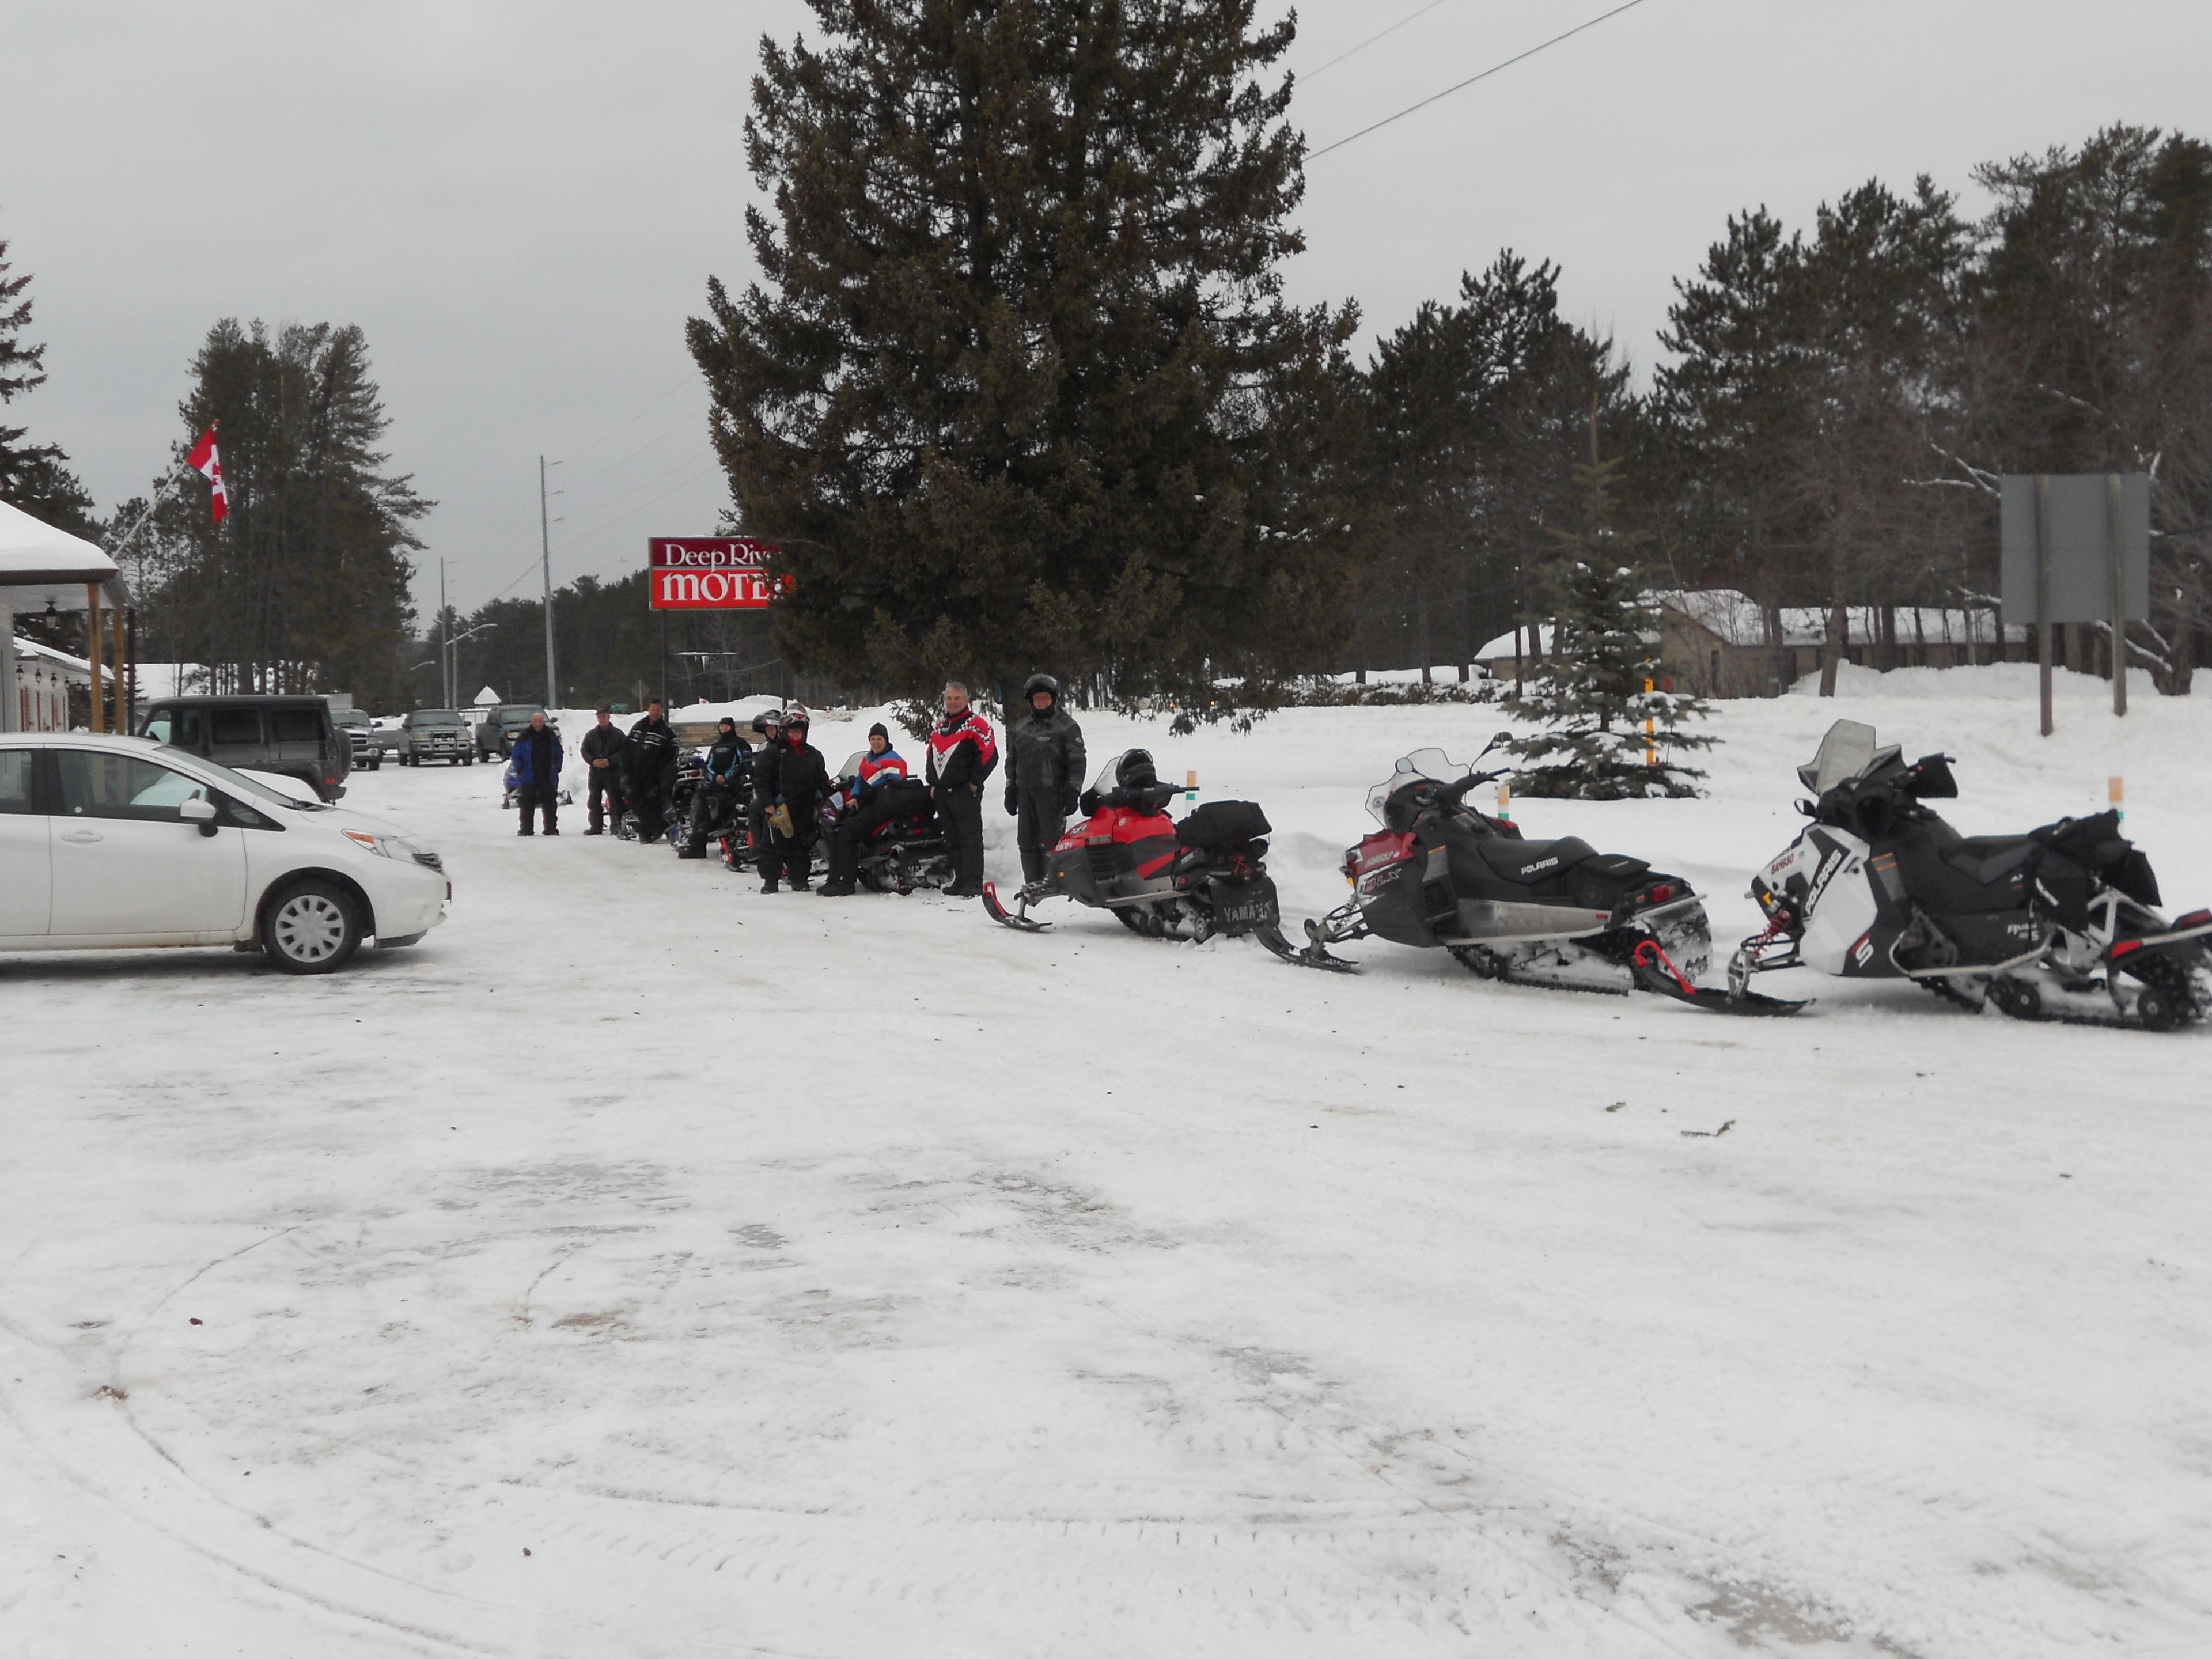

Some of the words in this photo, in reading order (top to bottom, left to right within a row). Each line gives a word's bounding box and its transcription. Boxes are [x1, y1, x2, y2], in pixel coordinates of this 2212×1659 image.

[664, 543, 726, 573] Deep
[728, 543, 772, 565] Riv
[1521, 856, 1559, 876] POLARIS
[1805, 849, 1842, 916] POLARIS
